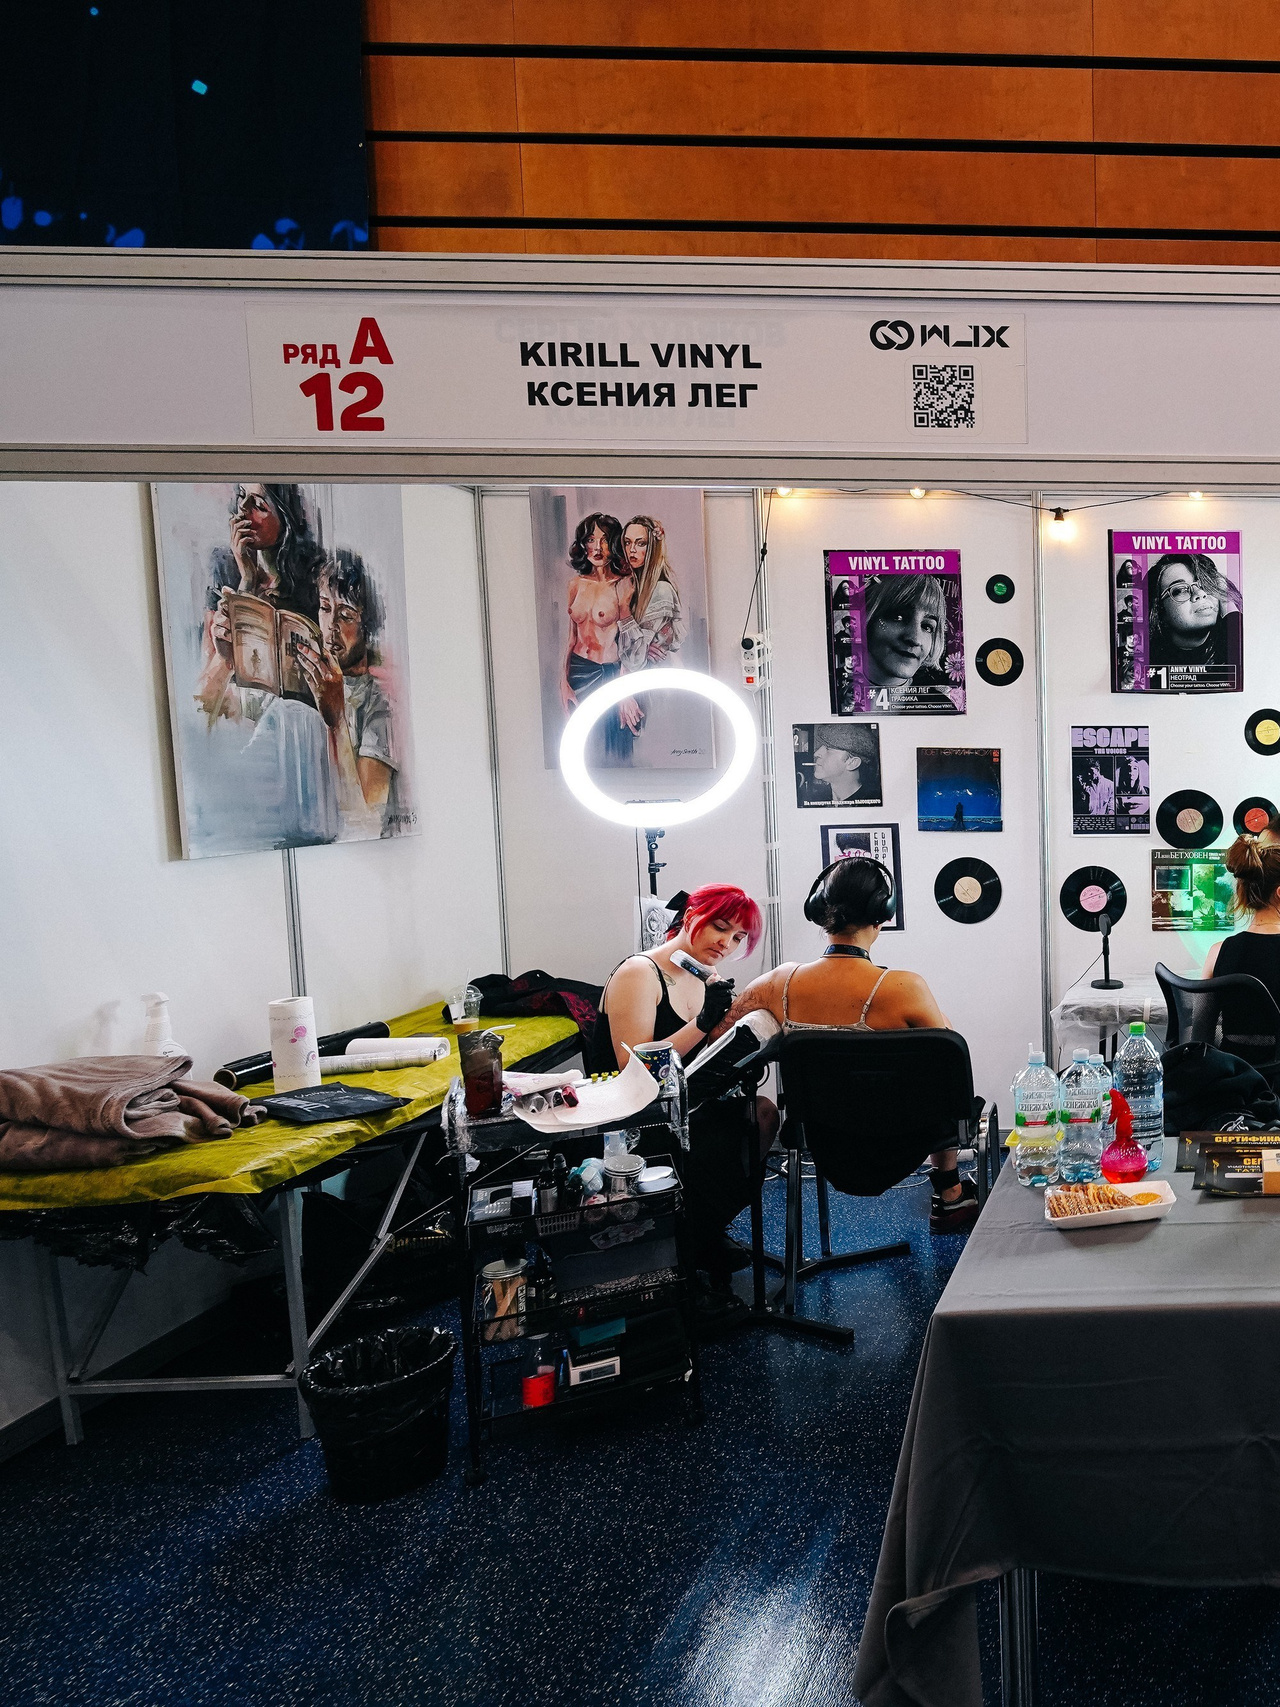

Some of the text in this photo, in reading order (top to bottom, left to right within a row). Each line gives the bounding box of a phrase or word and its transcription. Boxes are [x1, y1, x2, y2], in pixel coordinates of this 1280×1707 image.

[282, 342, 341, 370] РЯД
[520, 342, 762, 369] KIRILL VINYL
[299, 372, 387, 433] 12
[527, 381, 758, 408] КСЕНИЯ ЛЕГ
[1132, 536, 1227, 550] VINYL TATTOO
[848, 555, 945, 570] VINYL TATTOO
[1146, 667, 1168, 689] #1
[867, 688, 890, 711] #4
[1071, 728, 1149, 748] ESCAPE
[1170, 851, 1209, 859] БЕТХОВЕН
